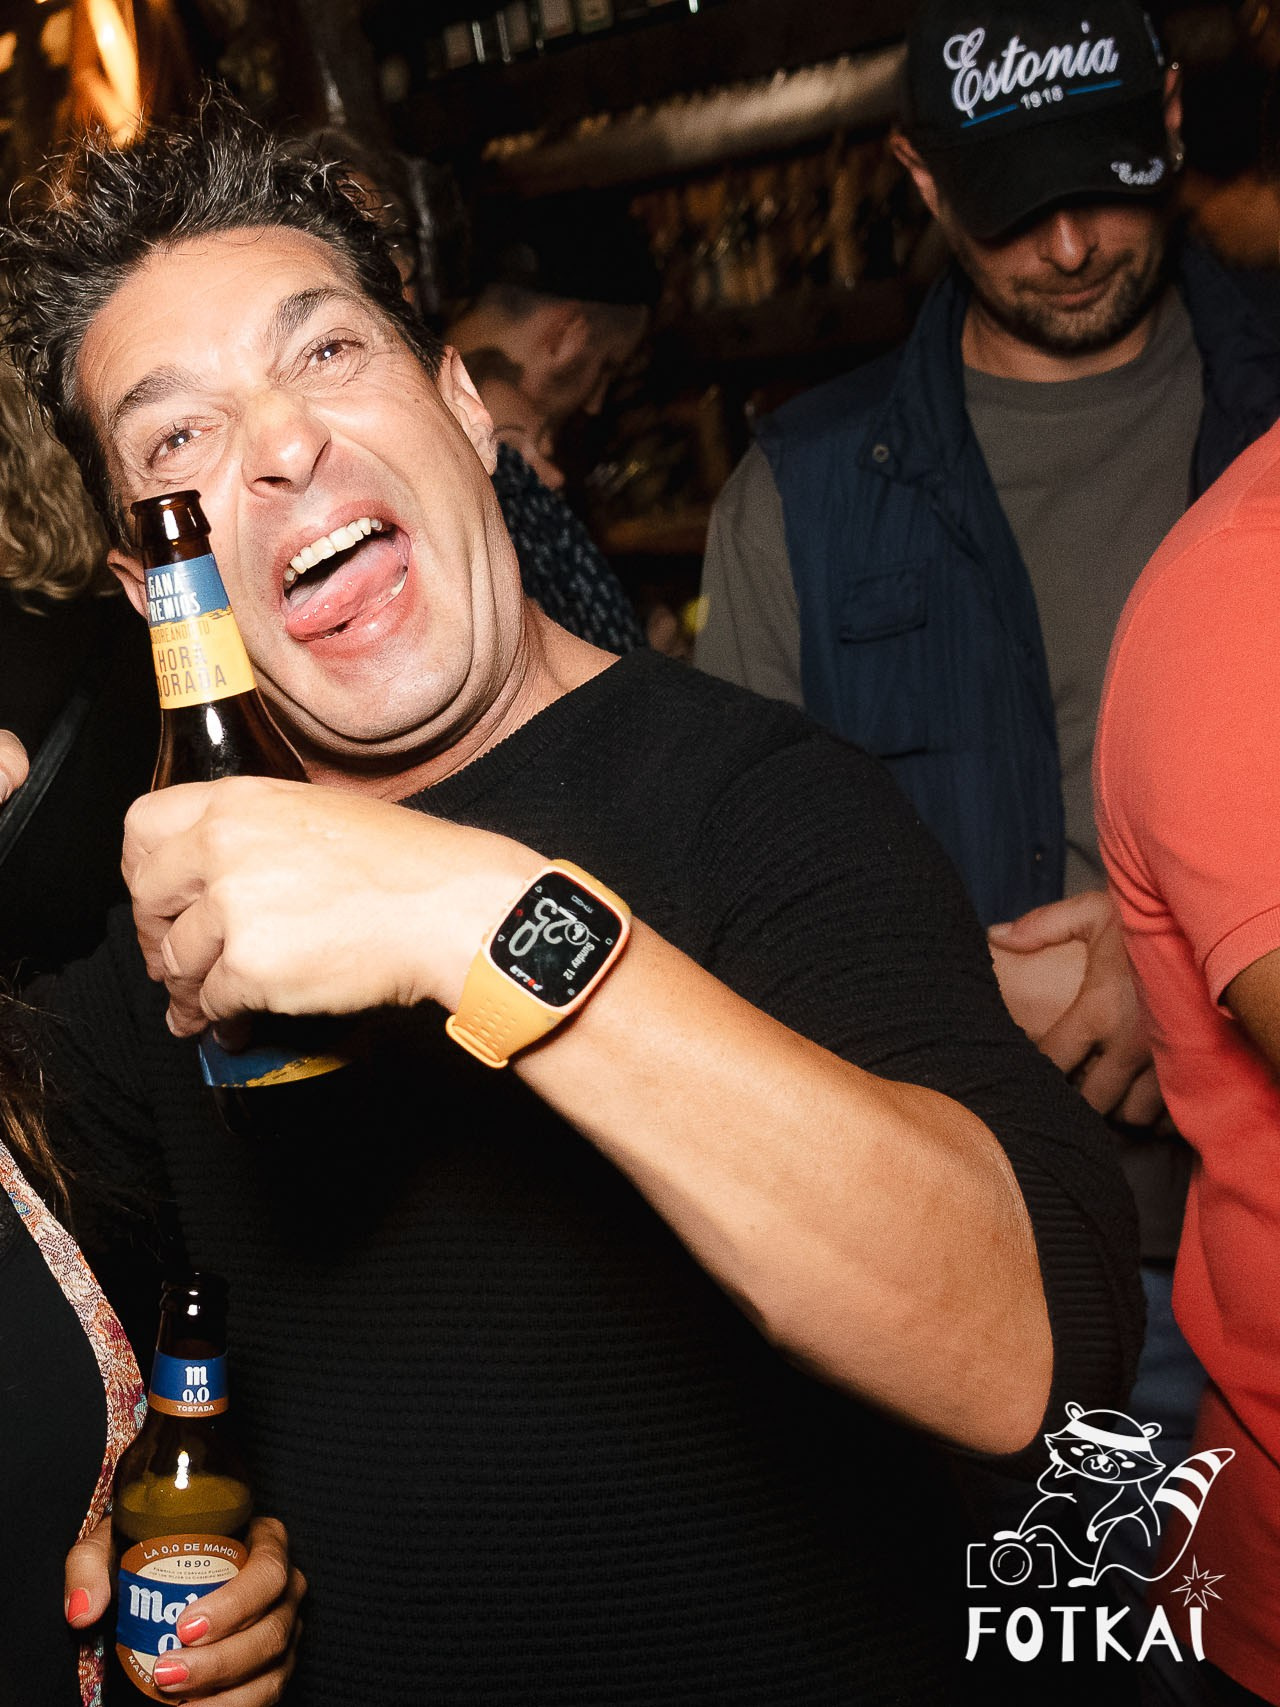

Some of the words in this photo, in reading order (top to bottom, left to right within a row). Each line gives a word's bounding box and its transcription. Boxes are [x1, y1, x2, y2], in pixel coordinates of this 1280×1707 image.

[943, 20, 1120, 119] Estonia
[1020, 85, 1064, 109] 1918
[571, 942, 595, 968] Sunday
[563, 968, 576, 980] 12
[177, 1404, 215, 1413] TOSTADA
[144, 1550, 159, 1560] LA
[183, 1543, 201, 1552] DE
[203, 1543, 239, 1559] MAHOU
[176, 1559, 211, 1568] 1890
[128, 1655, 155, 1687] MAES
